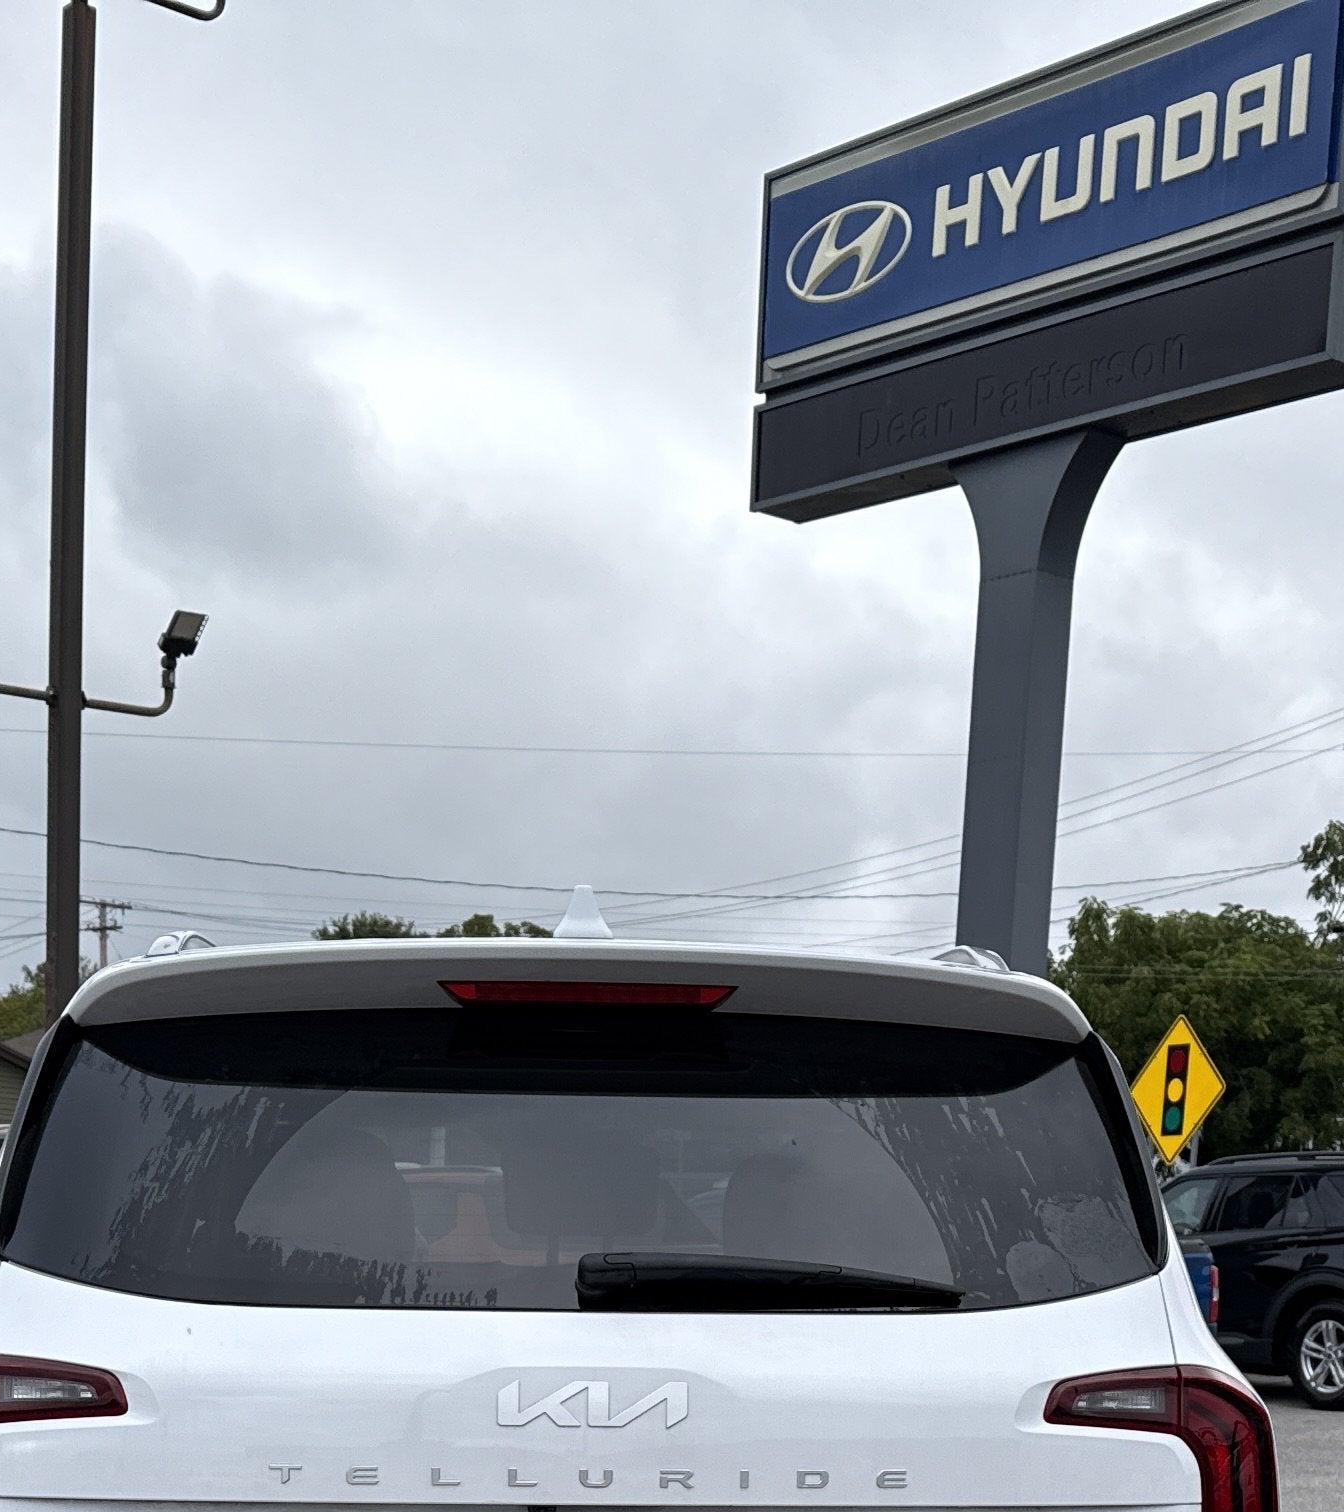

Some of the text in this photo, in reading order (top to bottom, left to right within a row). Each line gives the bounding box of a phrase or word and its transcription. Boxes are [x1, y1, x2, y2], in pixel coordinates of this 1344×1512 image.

[931, 52, 1313, 259] HYUNDAI
[856, 333, 1190, 459] Dean Patterson
[496, 1379, 690, 1430] KIA
[268, 1462, 909, 1491] TELLURIDE
